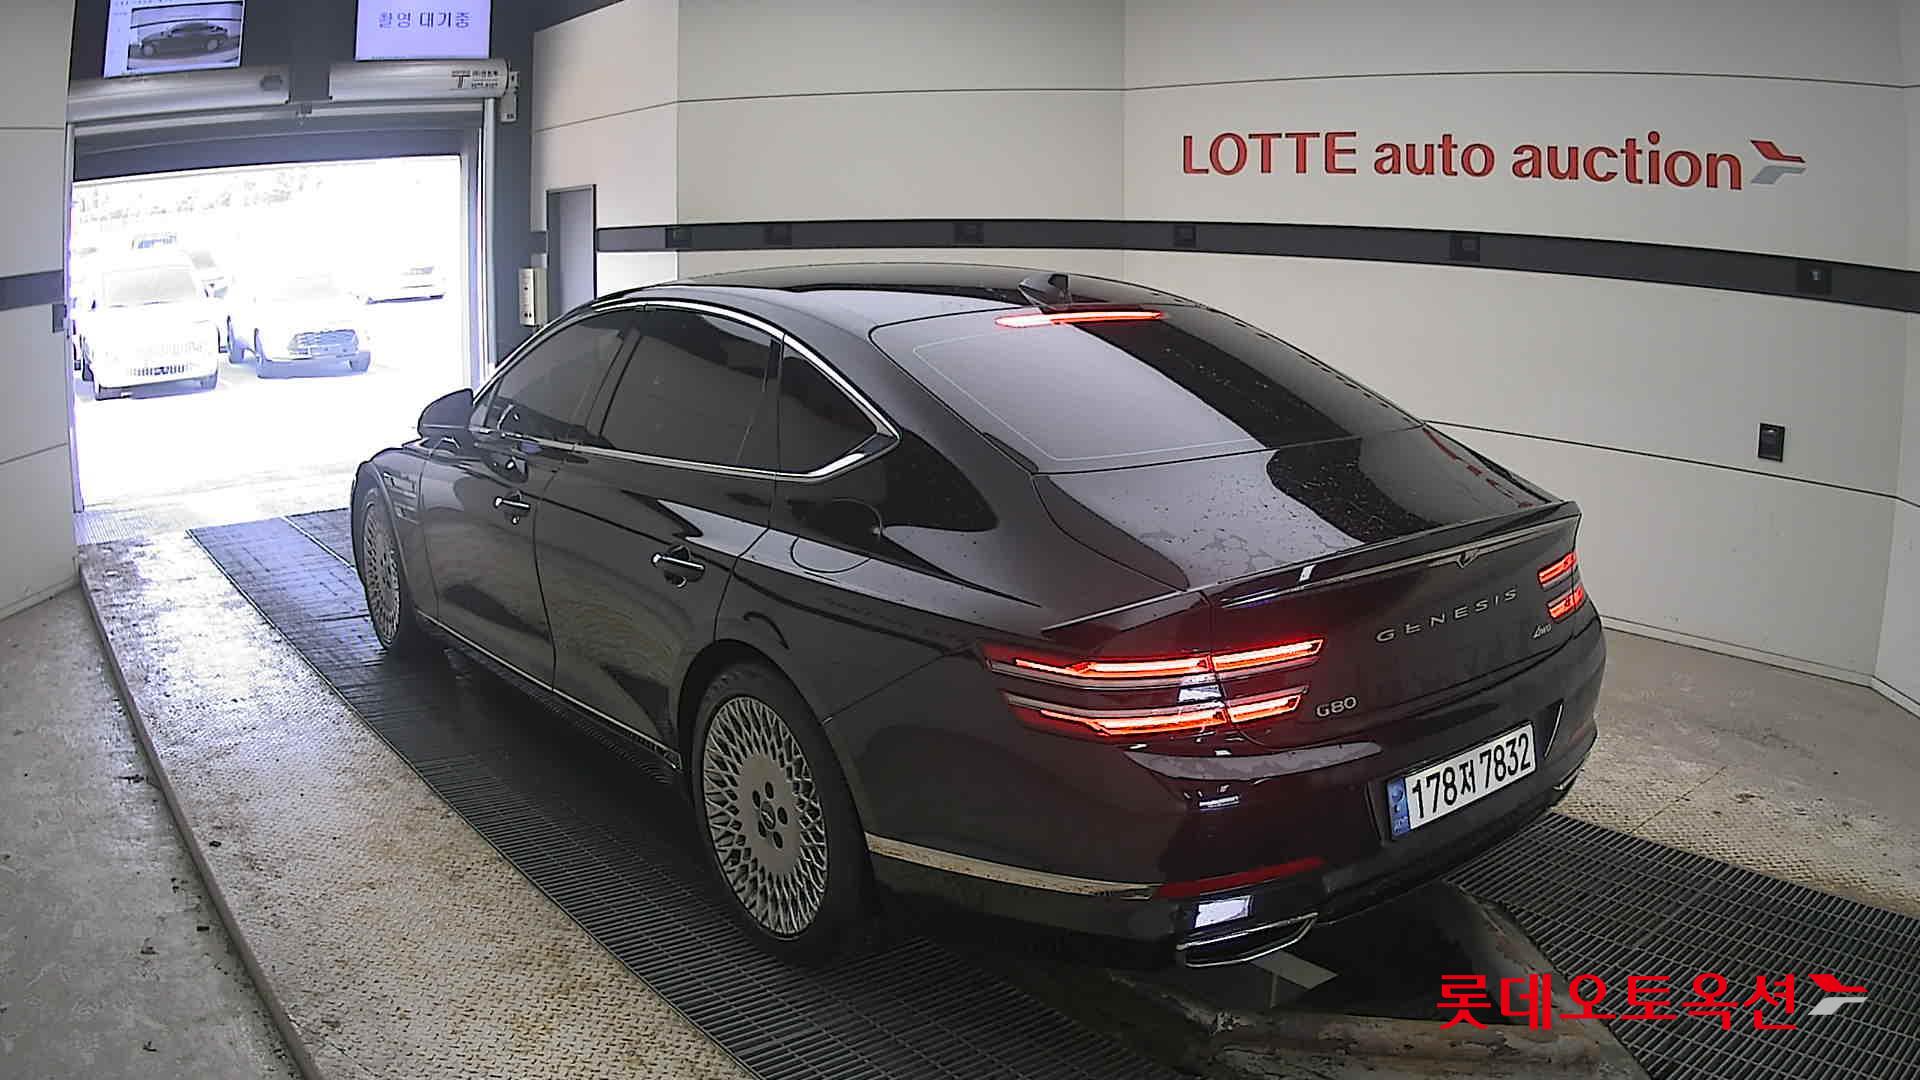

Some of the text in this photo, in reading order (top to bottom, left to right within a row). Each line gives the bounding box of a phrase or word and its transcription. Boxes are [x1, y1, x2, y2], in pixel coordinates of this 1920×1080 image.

[420, 12, 470, 28] 대기중
[1183, 131, 1742, 190] LOTTE auto auction
[1376, 588, 1518, 642] GENESIS
[1316, 697, 1358, 718] G80
[1412, 733, 1531, 818] 178저 7832
